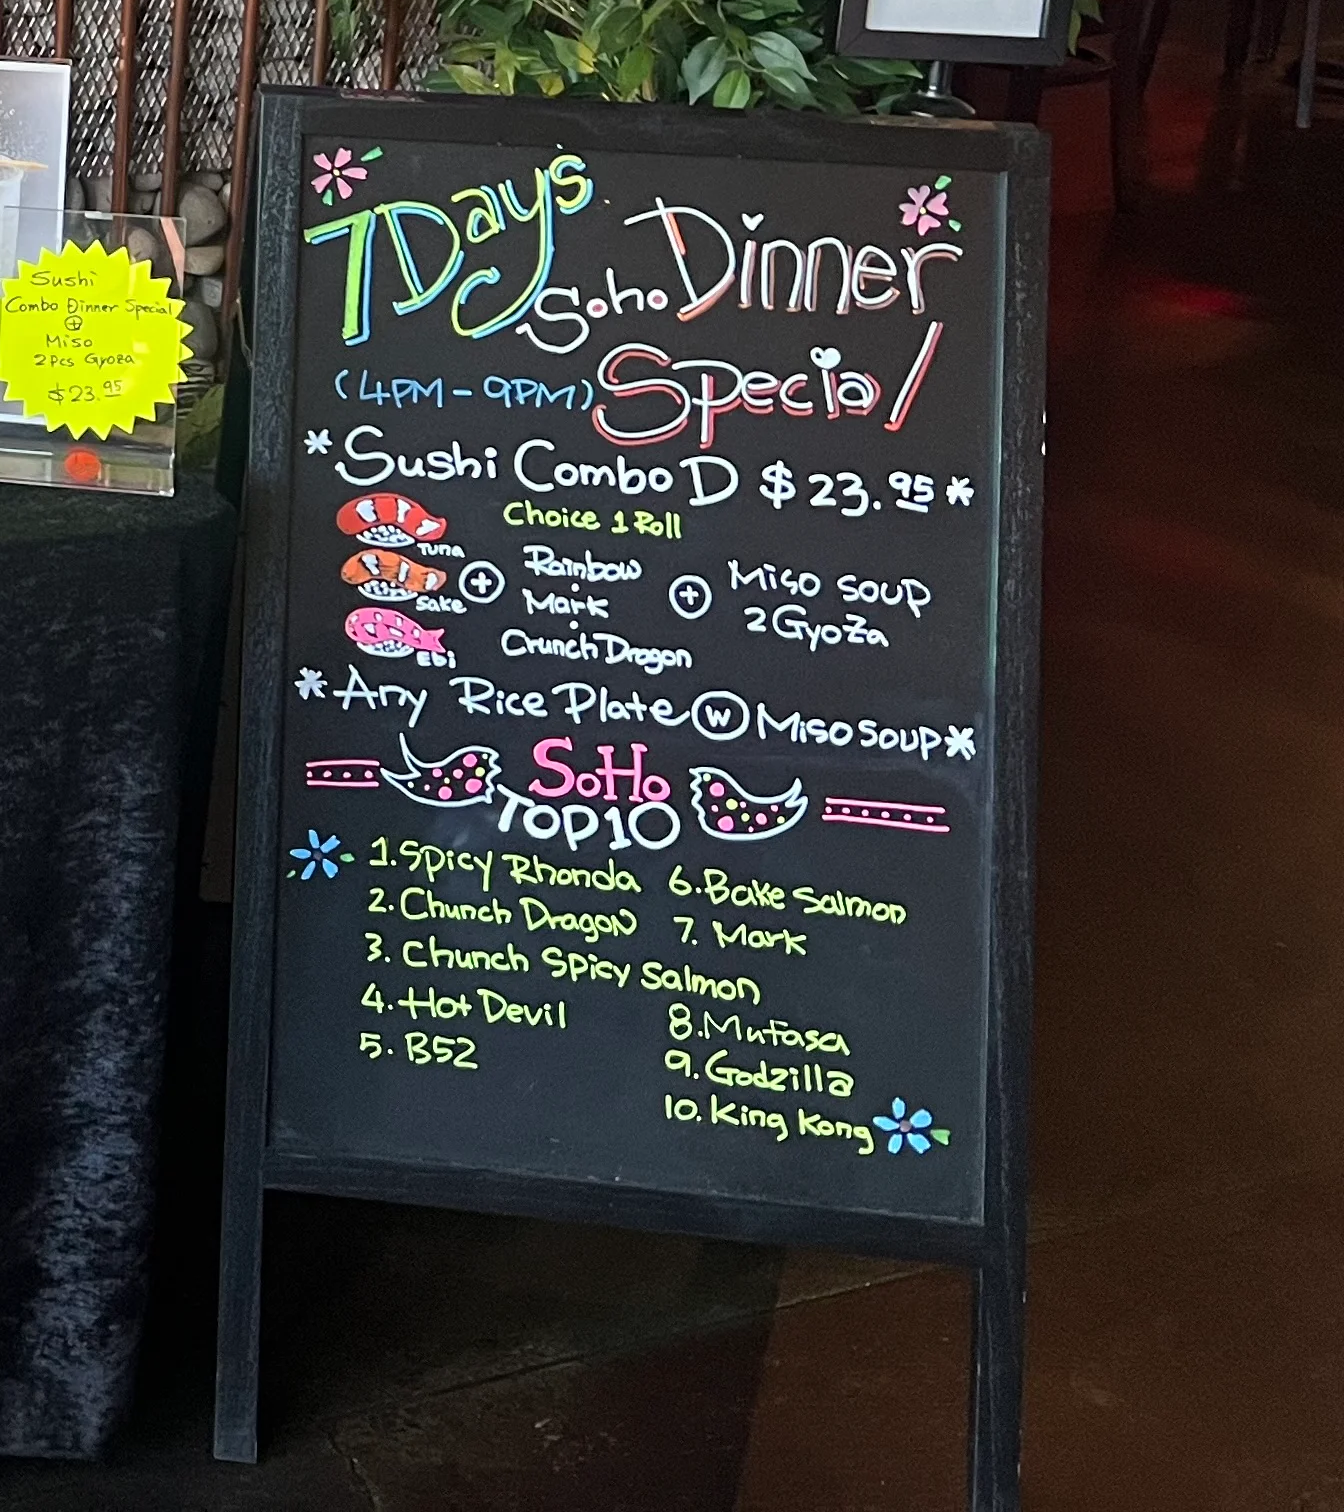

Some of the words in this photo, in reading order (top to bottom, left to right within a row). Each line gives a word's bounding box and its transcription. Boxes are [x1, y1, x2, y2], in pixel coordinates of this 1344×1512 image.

[30, 270, 97, 287] Sushi
[515, 267, 669, 355] Soho
[623, 196, 965, 323] Dinner
[5, 295, 58, 313] Combo
[67, 297, 119, 315] Dinner
[125, 299, 173, 321] Special
[46, 333, 93, 348] Miso
[84, 353, 136, 369] Gyoza
[47, 380, 123, 406] $23.95
[591, 319, 945, 451] Special
[333, 423, 500, 487] Sushi
[512, 438, 676, 496] Combo
[679, 454, 741, 508] D
[611, 509, 630, 534] 1
[633, 510, 684, 540] Roll
[522, 544, 644, 583] Rainbow
[521, 588, 611, 620] Mark
[415, 650, 458, 669] Ebi
[500, 628, 599, 665] Crunch
[592, 632, 693, 676] Dragon
[332, 663, 429, 728] Any
[448, 675, 550, 719] Rice
[550, 681, 691, 727] Plate
[500, 852, 643, 894] Rhonda
[792, 886, 908, 926] Salmon
[712, 920, 808, 957] Mark
[541, 946, 632, 990] Spicy
[640, 960, 762, 1006] Salmon
[476, 988, 567, 1030] Devil
[404, 1031, 480, 1070] B52
[710, 1093, 790, 1143] King
[797, 1108, 877, 1156] Kong
